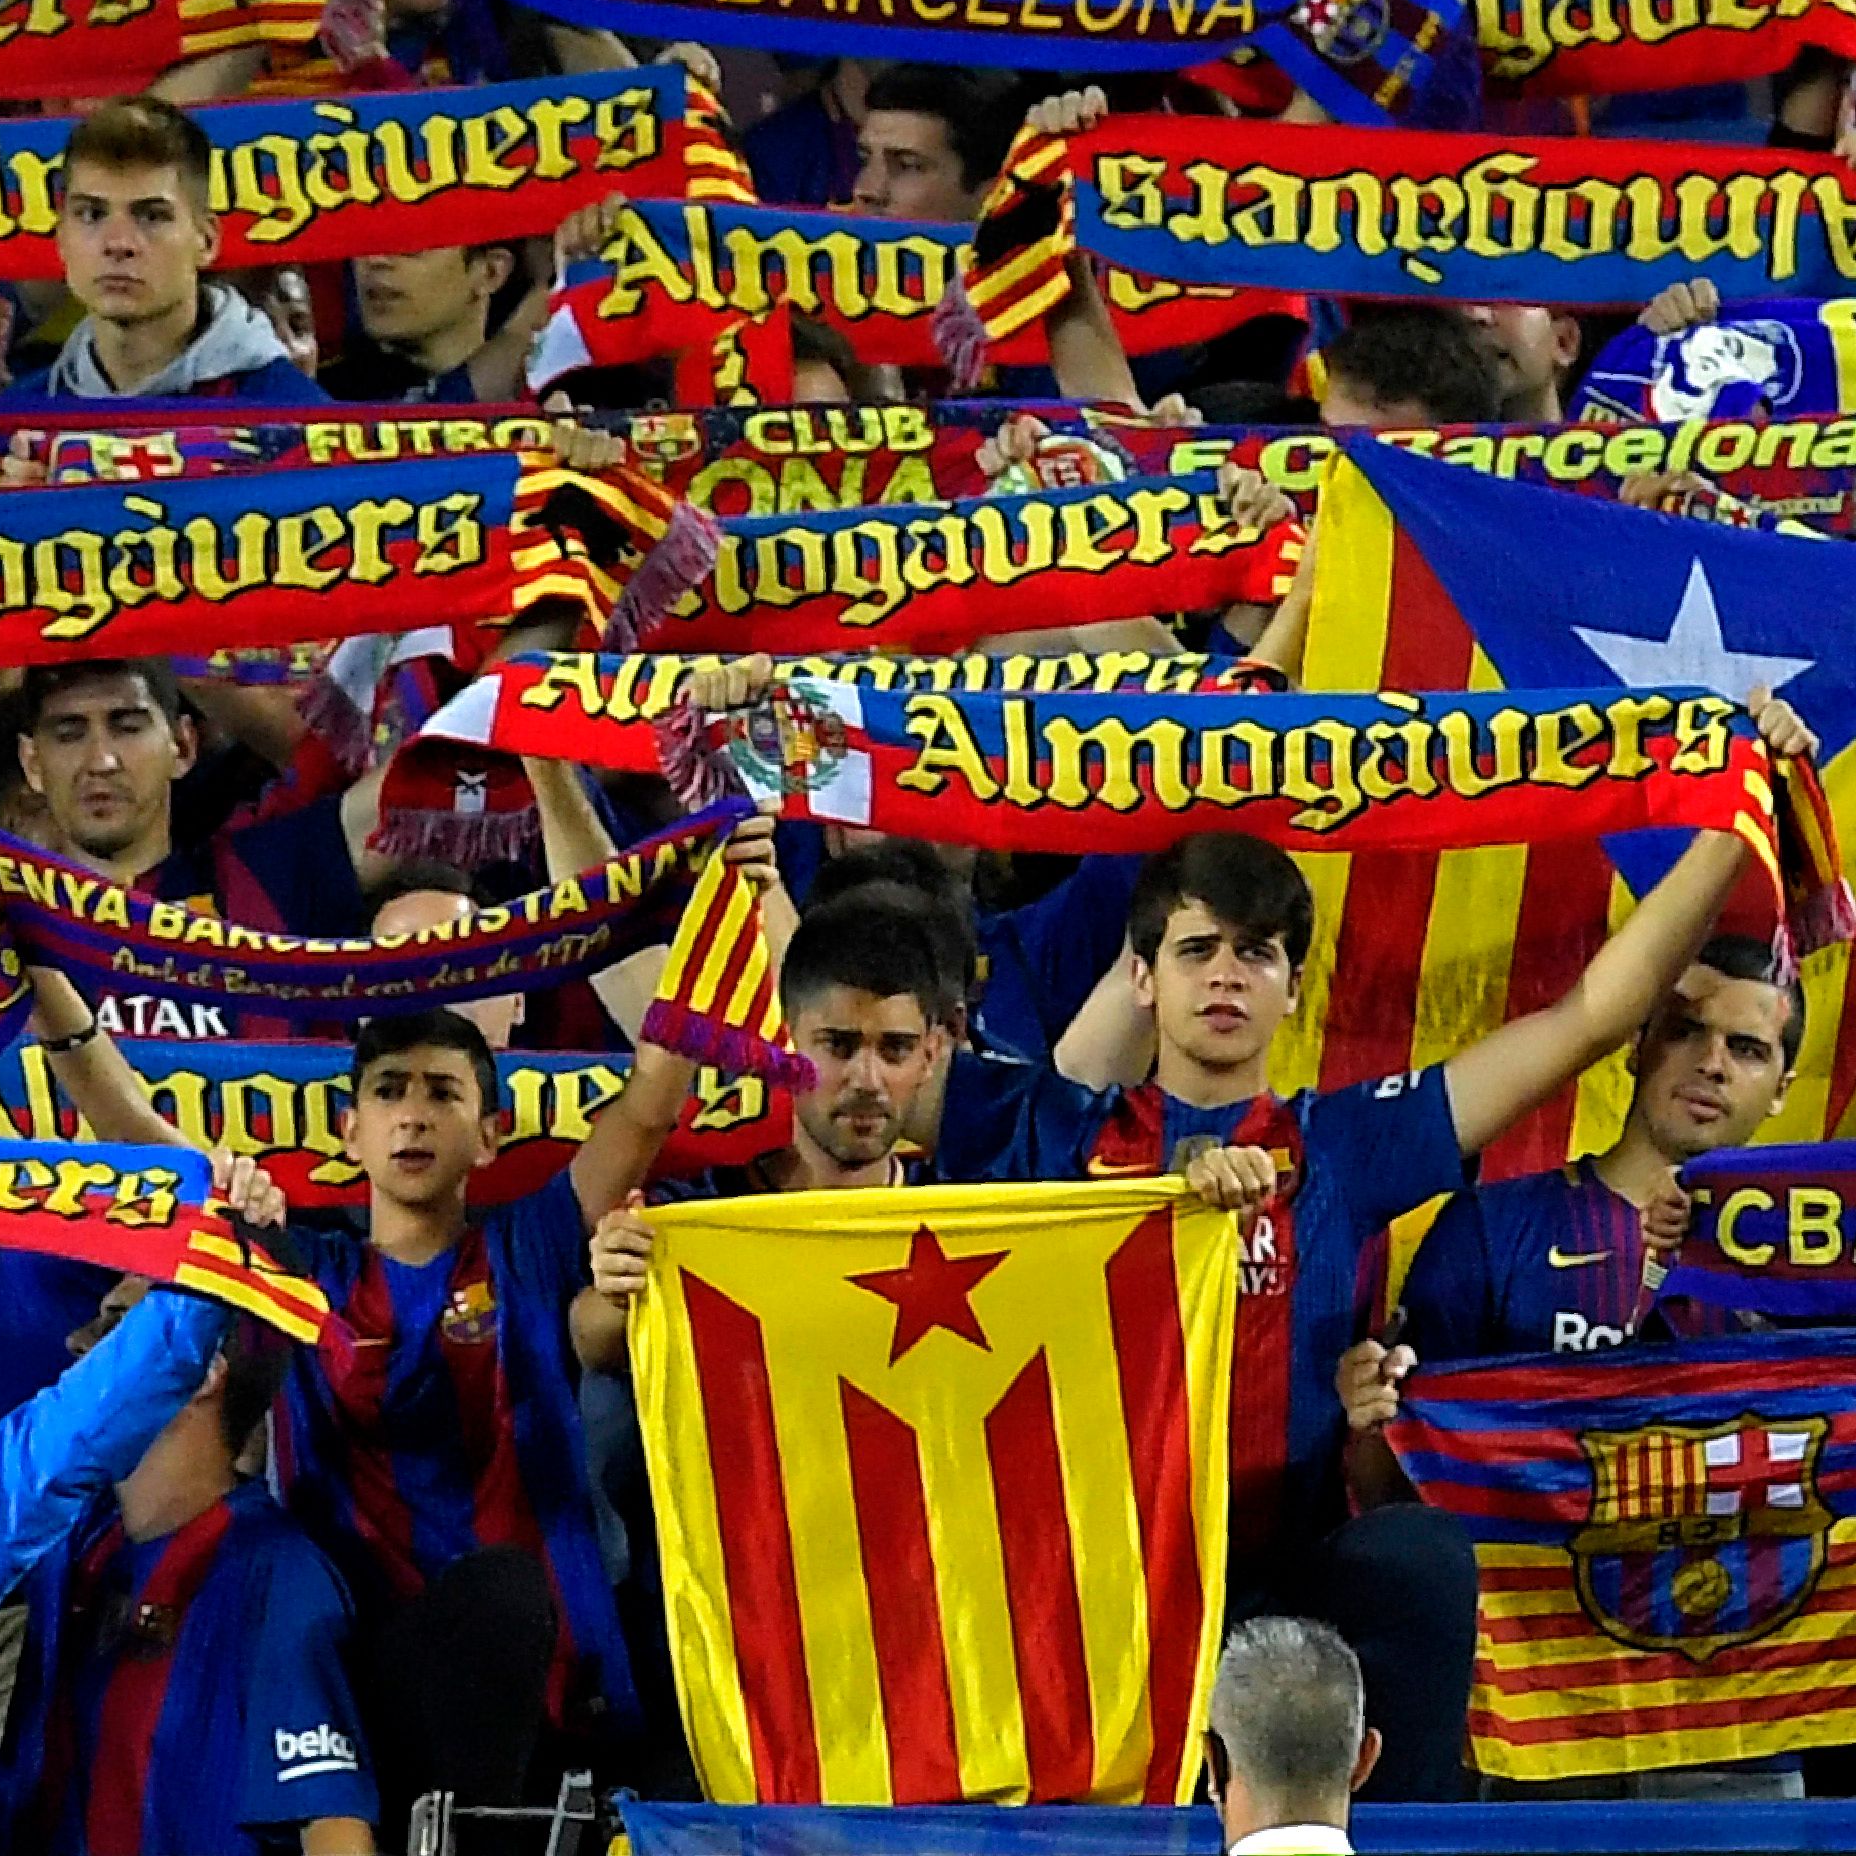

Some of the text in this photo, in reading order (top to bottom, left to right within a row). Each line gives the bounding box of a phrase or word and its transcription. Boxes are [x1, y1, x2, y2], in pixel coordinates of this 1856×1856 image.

[743, 406, 935, 455] CLUB
[896, 691, 1736, 832] Almogàvers
[146, 880, 593, 952] BARNISTA
[96, 992, 231, 1038] ATAR
[1553, 1310, 1634, 1353] Ra
